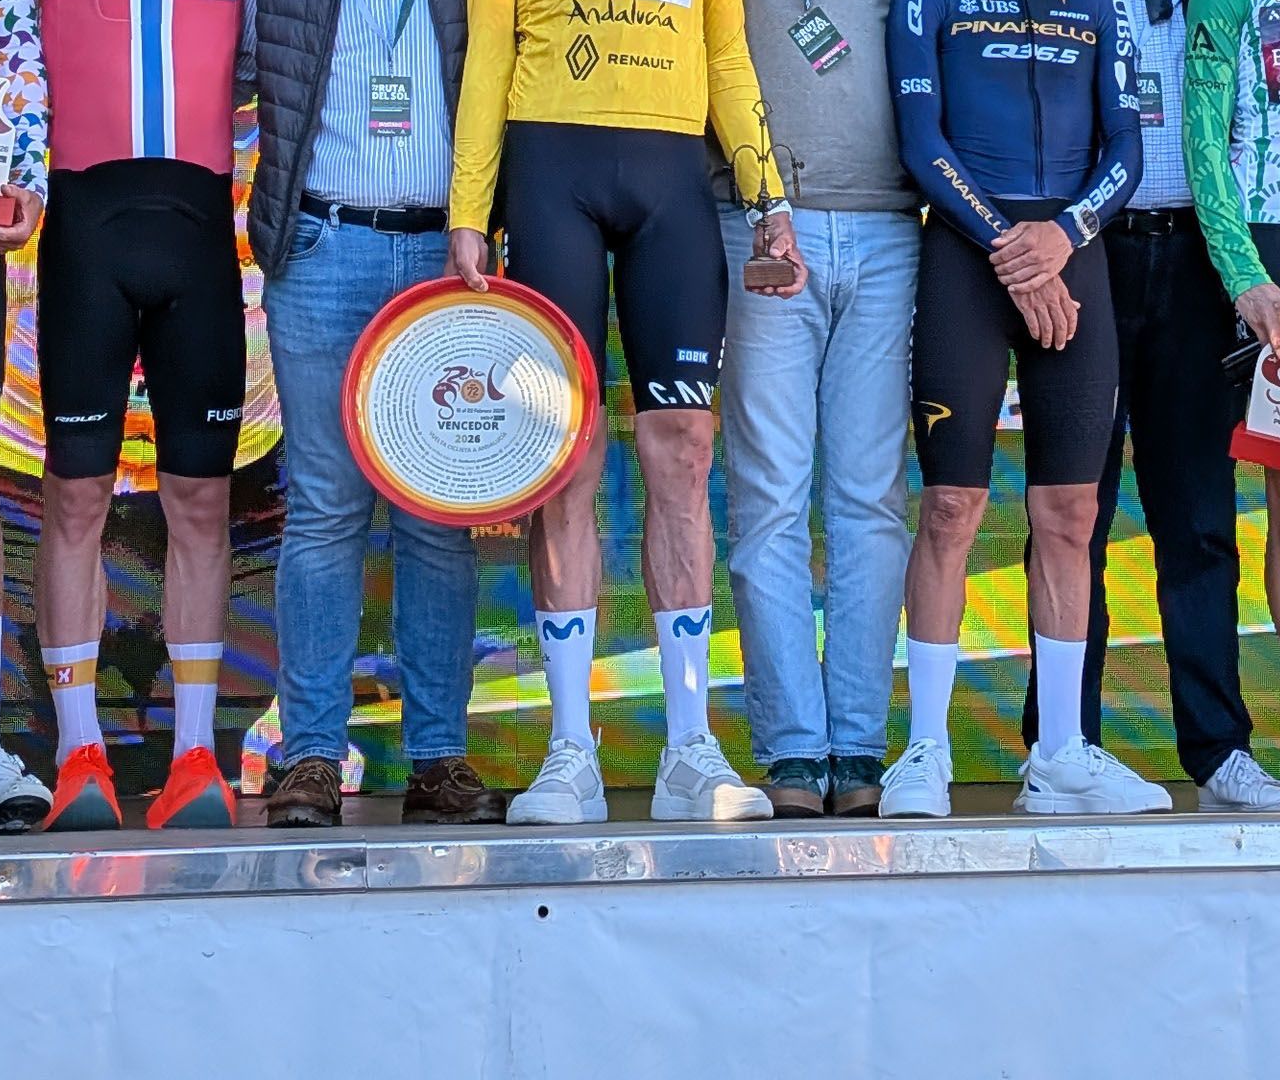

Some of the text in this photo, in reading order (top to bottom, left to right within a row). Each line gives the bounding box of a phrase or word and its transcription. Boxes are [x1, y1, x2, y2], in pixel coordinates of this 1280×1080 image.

[981, 0, 1090, 21] UBS SRAM
[950, 19, 1097, 45] PINARELLO
[981, 42, 1080, 64] Q36.5
[607, 52, 675, 71] RENAULT
[379, 84, 405, 93] RUTA
[900, 77, 933, 94] SGS
[371, 92, 389, 100] DEL
[677, 349, 708, 364] GOBIK
[467, 386, 480, 397] 72
[55, 412, 108, 423] RIDLEY
[437, 421, 499, 431] VENCEDOR
[455, 434, 481, 444] 2026
